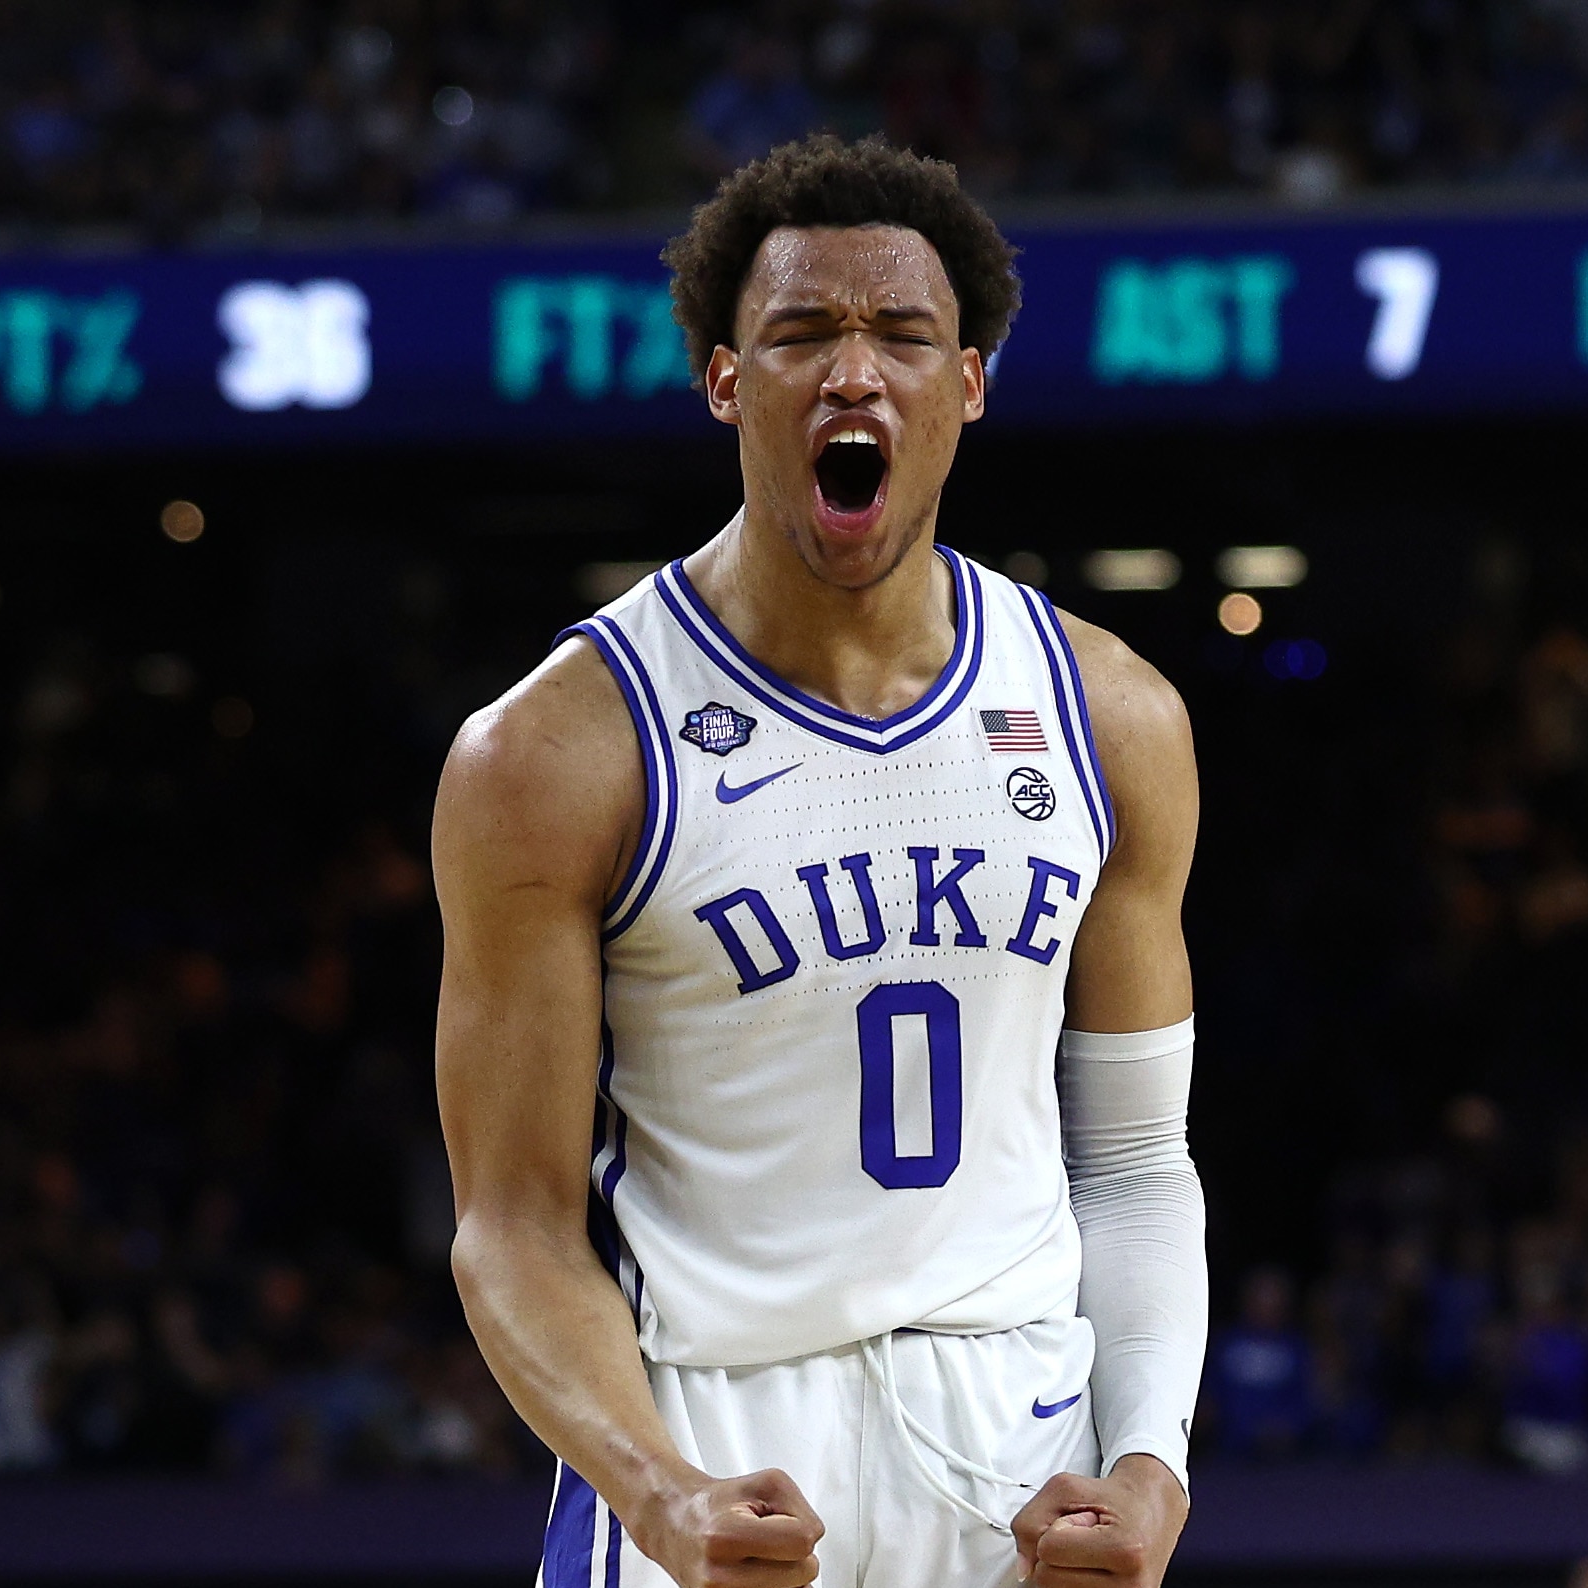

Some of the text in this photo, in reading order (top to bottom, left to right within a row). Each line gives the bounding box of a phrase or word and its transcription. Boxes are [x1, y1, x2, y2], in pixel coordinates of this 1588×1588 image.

[219, 280, 370, 410] 36
[1093, 255, 1293, 382] AST
[1357, 248, 1437, 378] 7
[703, 713, 734, 729] FINAL
[703, 726, 734, 742] FOUR
[1015, 785, 1050, 796] ACC
[695, 846, 1081, 995] DUKE
[856, 980, 963, 1190] 0
